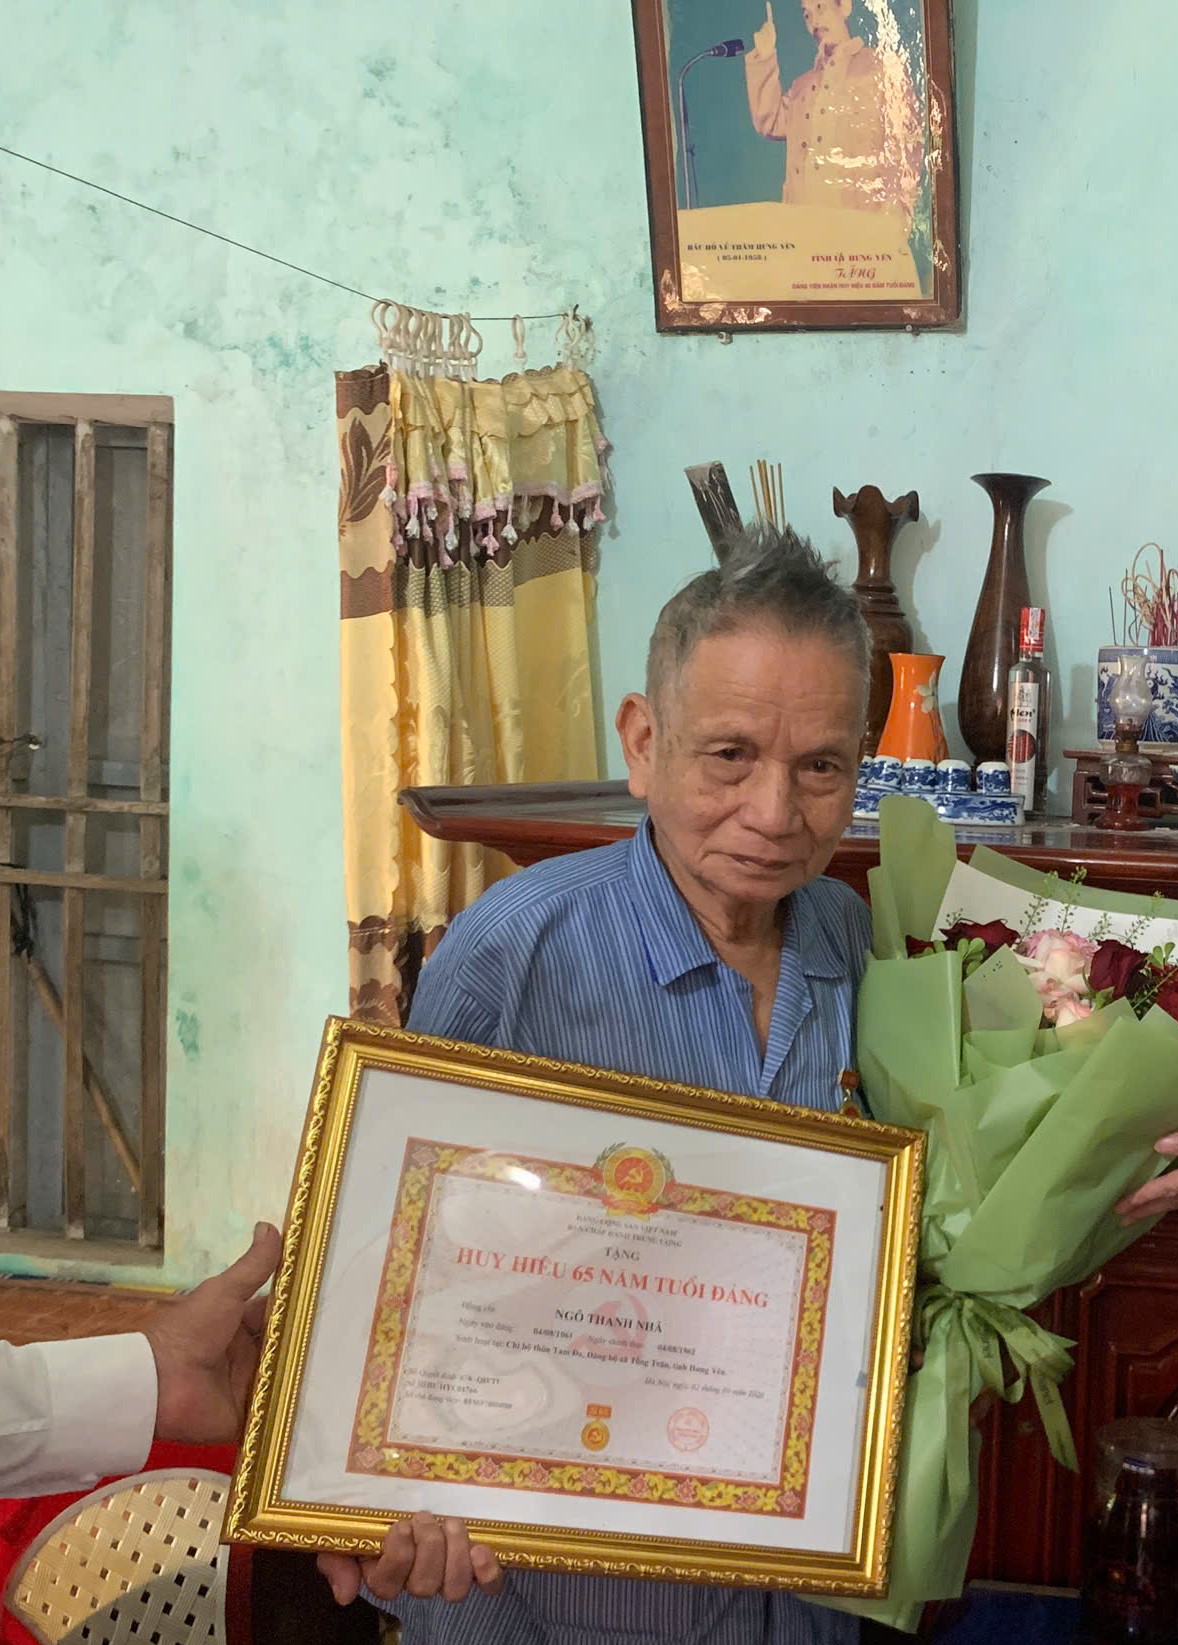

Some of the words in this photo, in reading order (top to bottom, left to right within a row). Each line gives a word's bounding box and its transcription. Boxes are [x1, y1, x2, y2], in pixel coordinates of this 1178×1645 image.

[605, 1246, 640, 1261] TẶNG
[457, 1247, 506, 1270] HUY
[572, 1265, 594, 1282] 65
[599, 1268, 649, 1290] NĂM
[654, 1275, 705, 1299] TUỔI
[711, 1283, 769, 1308] ĐẢNG
[555, 1309, 584, 1322] NGÔ
[587, 1313, 633, 1329] THANH
